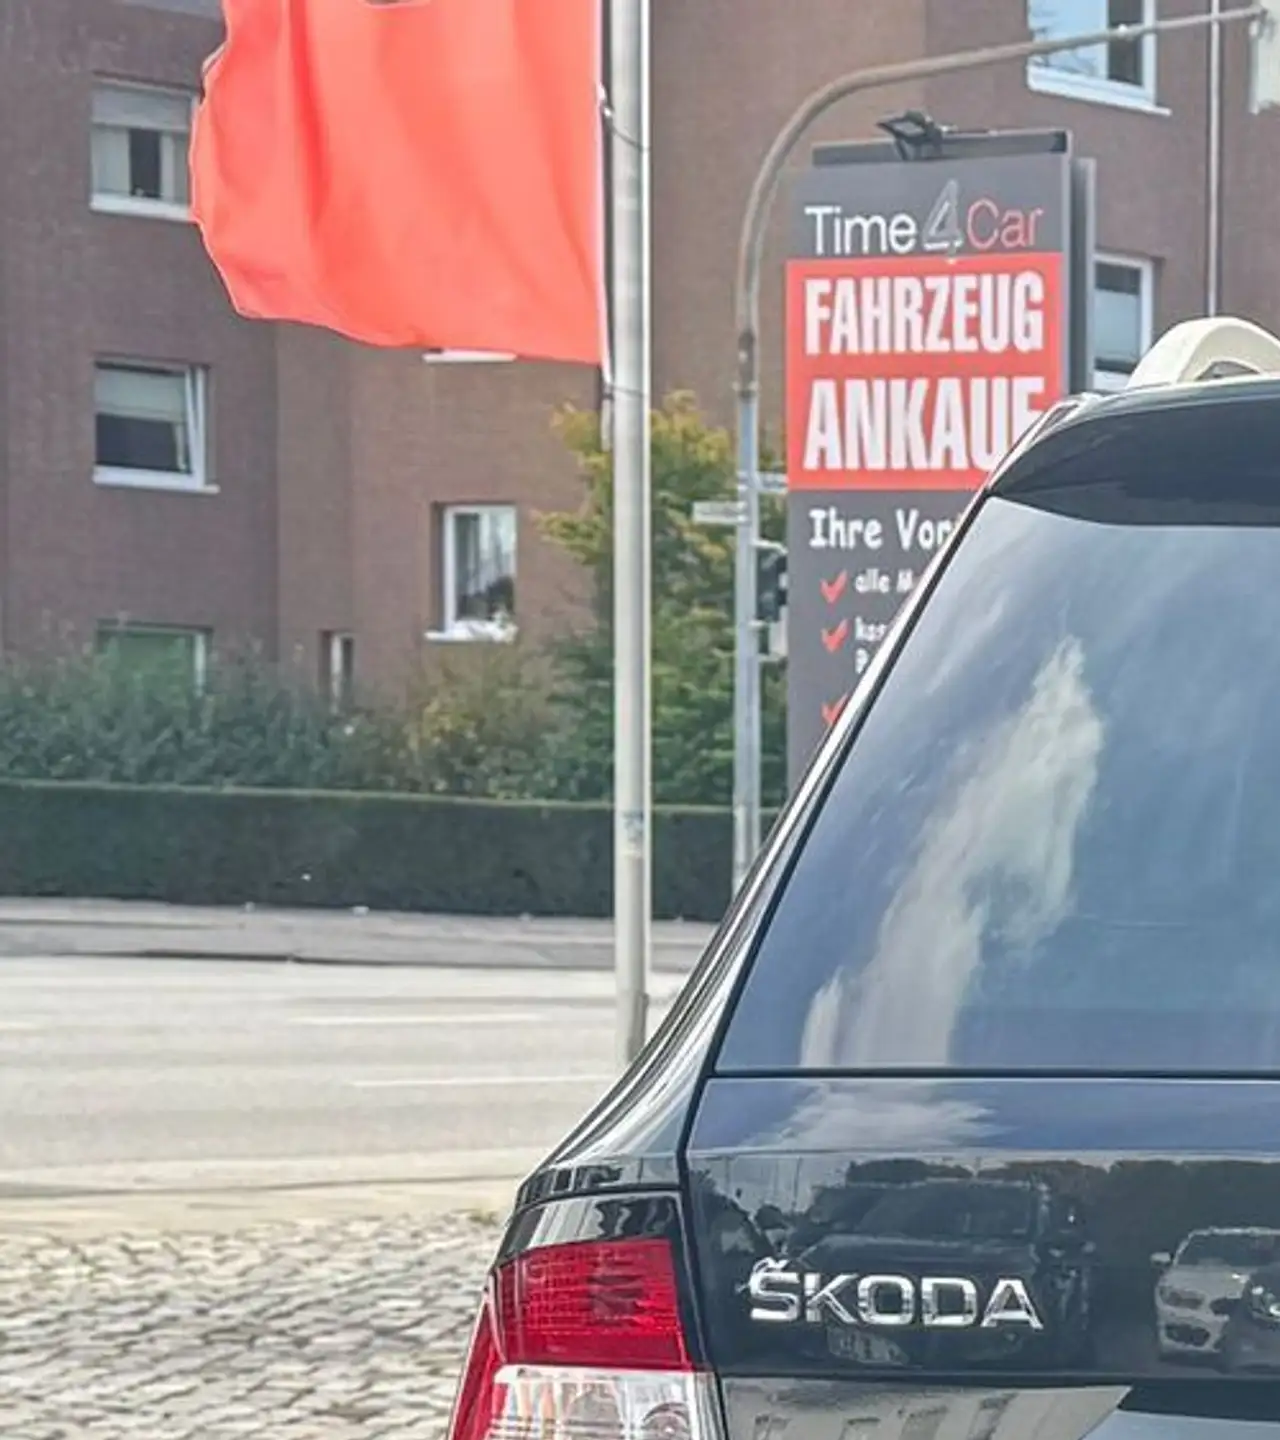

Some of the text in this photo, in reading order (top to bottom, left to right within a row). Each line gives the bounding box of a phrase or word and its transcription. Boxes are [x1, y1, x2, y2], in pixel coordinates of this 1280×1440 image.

[804, 178, 1044, 266] Time 4 Car
[804, 271, 1044, 357] FAHRZEUG
[808, 507, 884, 550] Ihre
[749, 1256, 1044, 1331] ŠKODA
